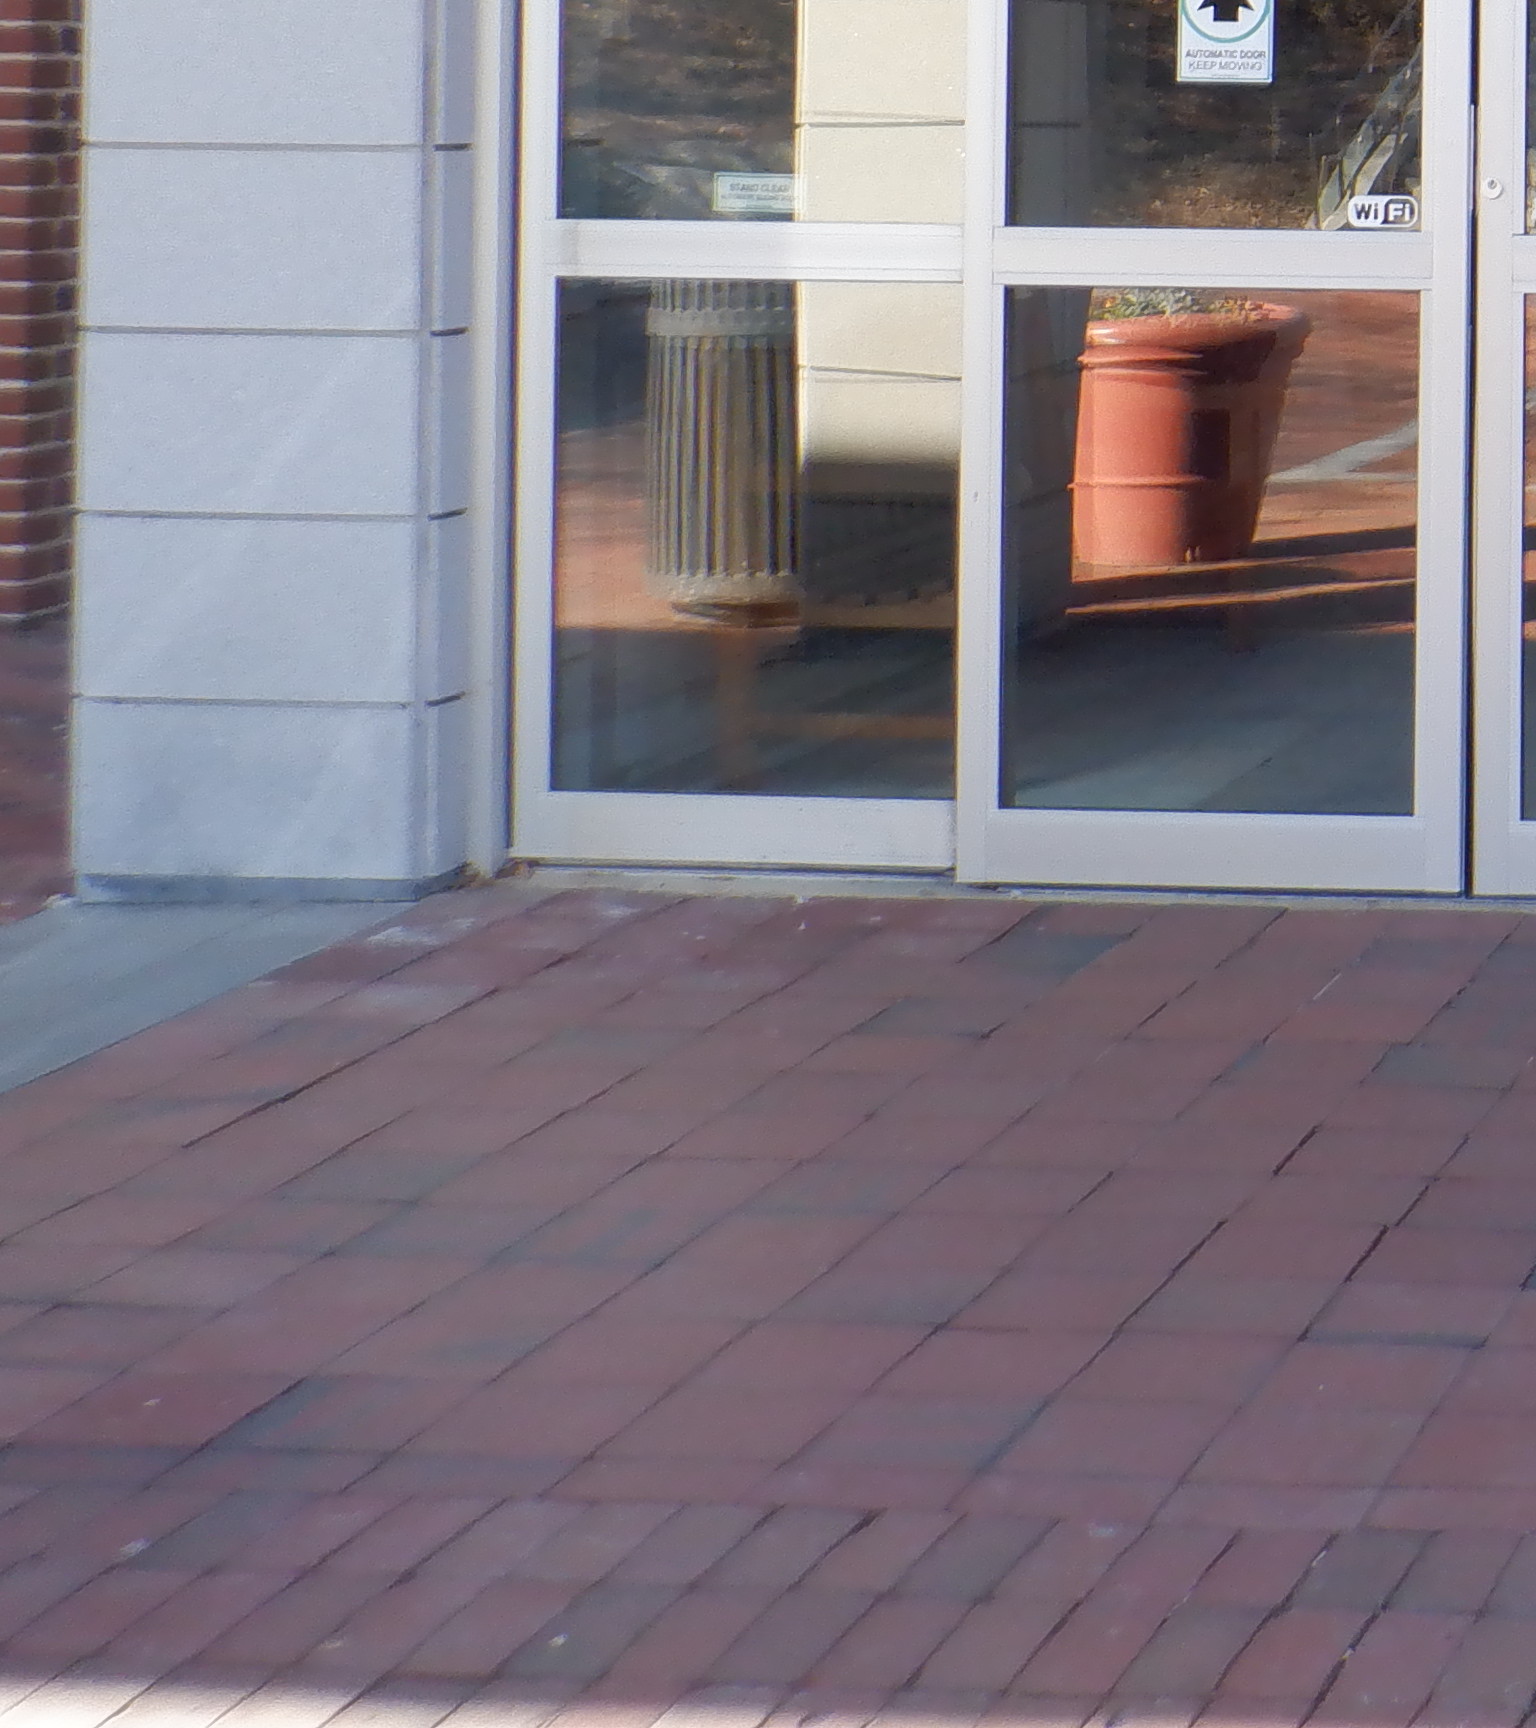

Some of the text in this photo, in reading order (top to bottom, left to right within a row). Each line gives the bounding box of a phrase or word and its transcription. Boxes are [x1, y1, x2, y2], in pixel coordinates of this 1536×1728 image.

[1185, 49, 1267, 60] AUTOMATIC DOOR
[1188, 59, 1217, 71] KEEP
